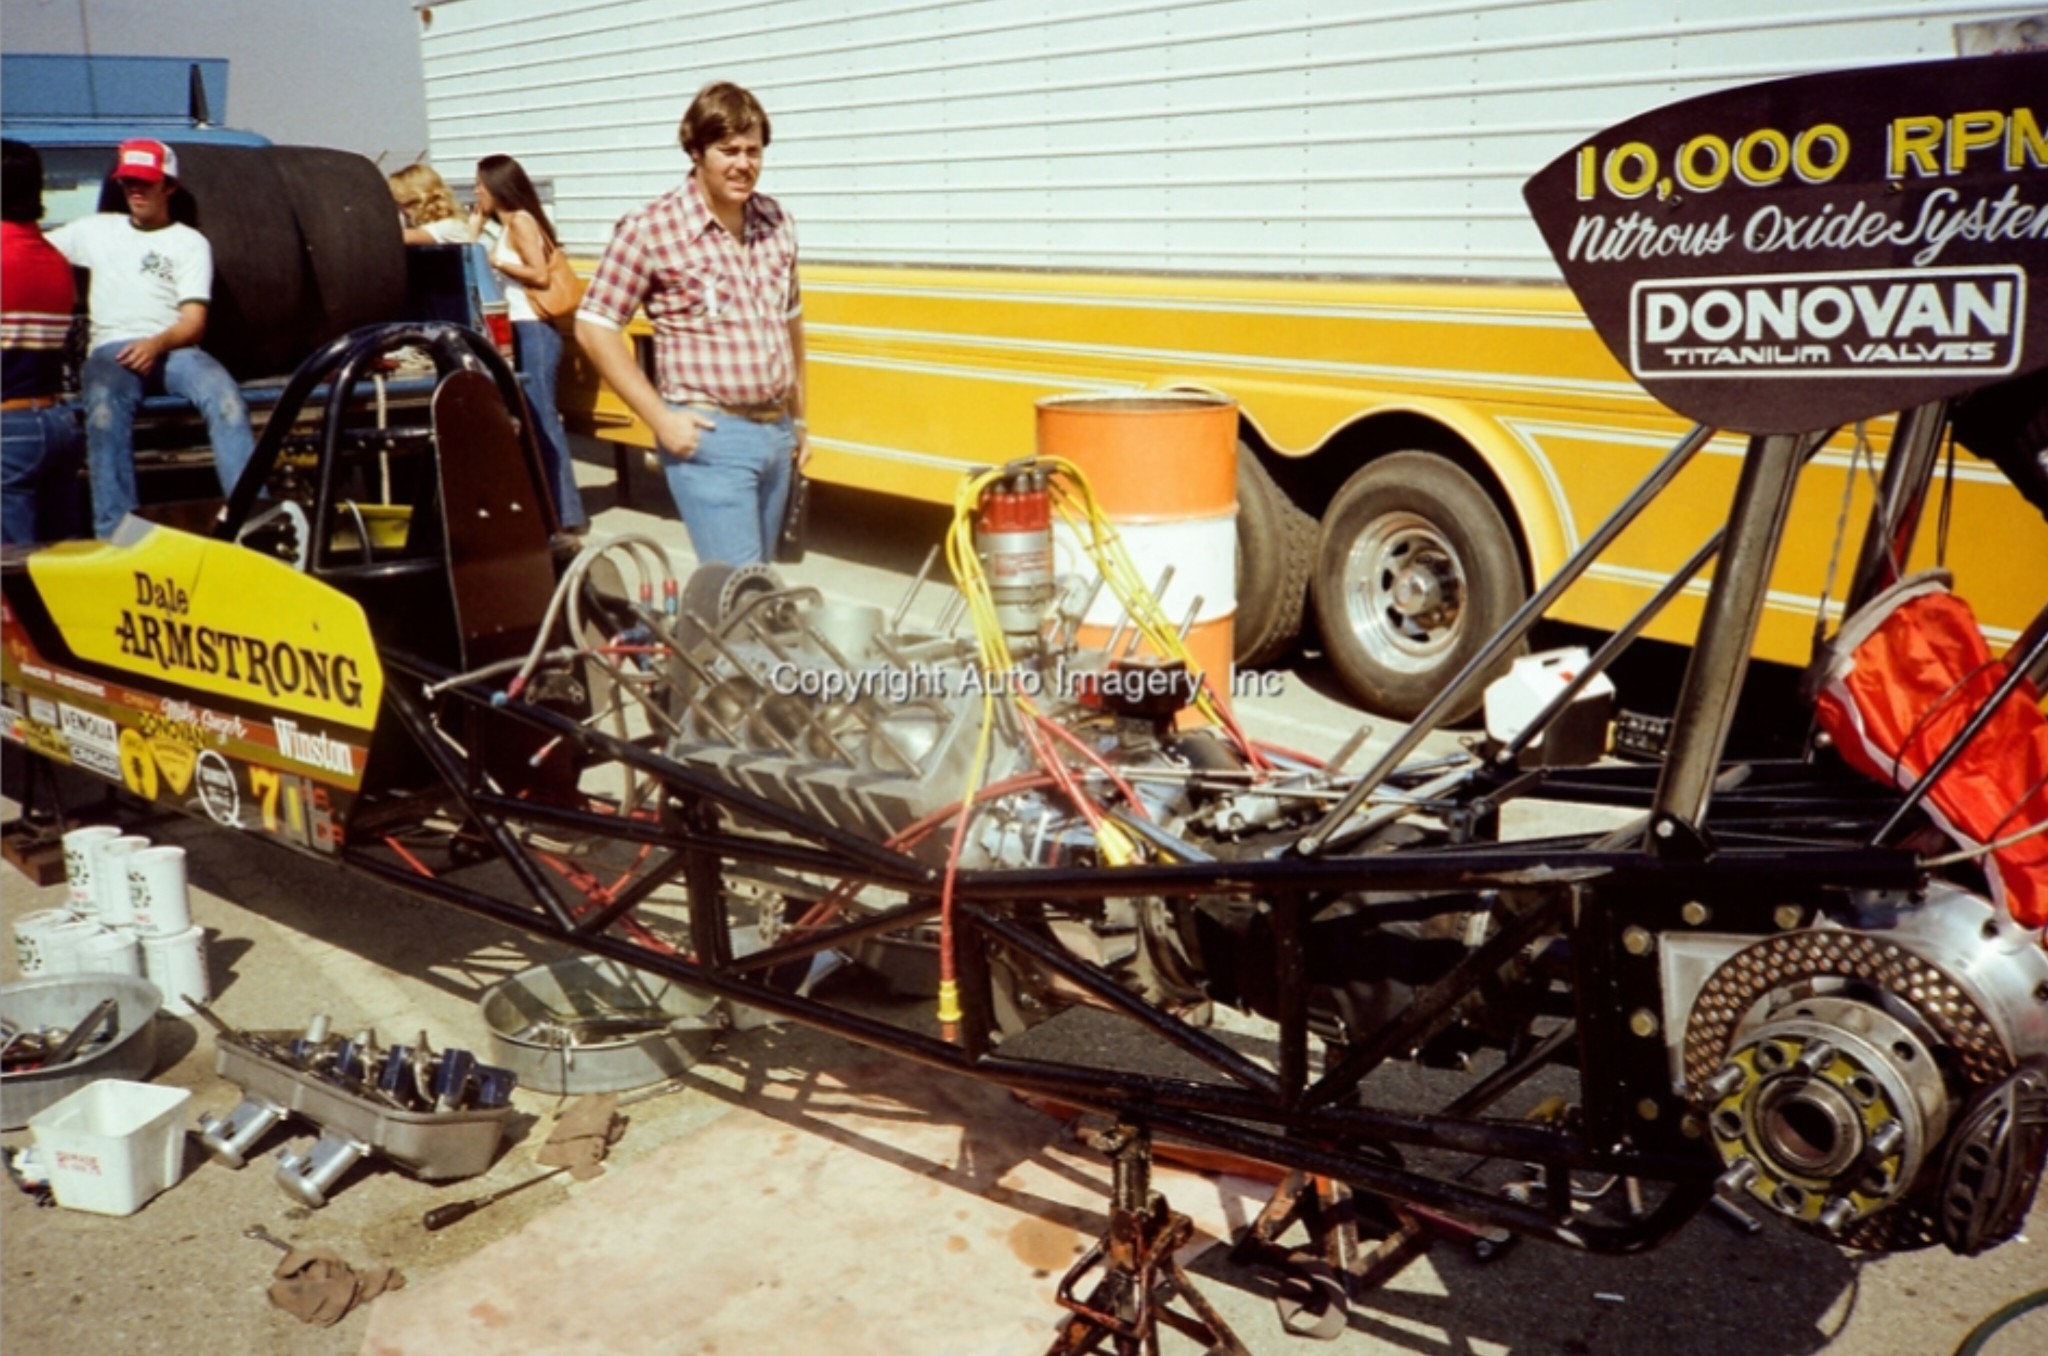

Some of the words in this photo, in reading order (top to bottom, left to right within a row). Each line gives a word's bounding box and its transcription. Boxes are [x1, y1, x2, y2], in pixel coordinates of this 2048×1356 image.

[1576, 124, 1849, 201] 10,000
[1567, 211, 1736, 262] Nitrous
[1743, 200, 1890, 252] Oxide
[1645, 282, 2013, 343] DONOVAN
[1664, 344, 1831, 365] TITANIUM
[1843, 342, 1998, 363] VALVES
[134, 571, 189, 615] Dale
[115, 609, 363, 709] ARMSTRONG
[272, 717, 355, 776] Winston
